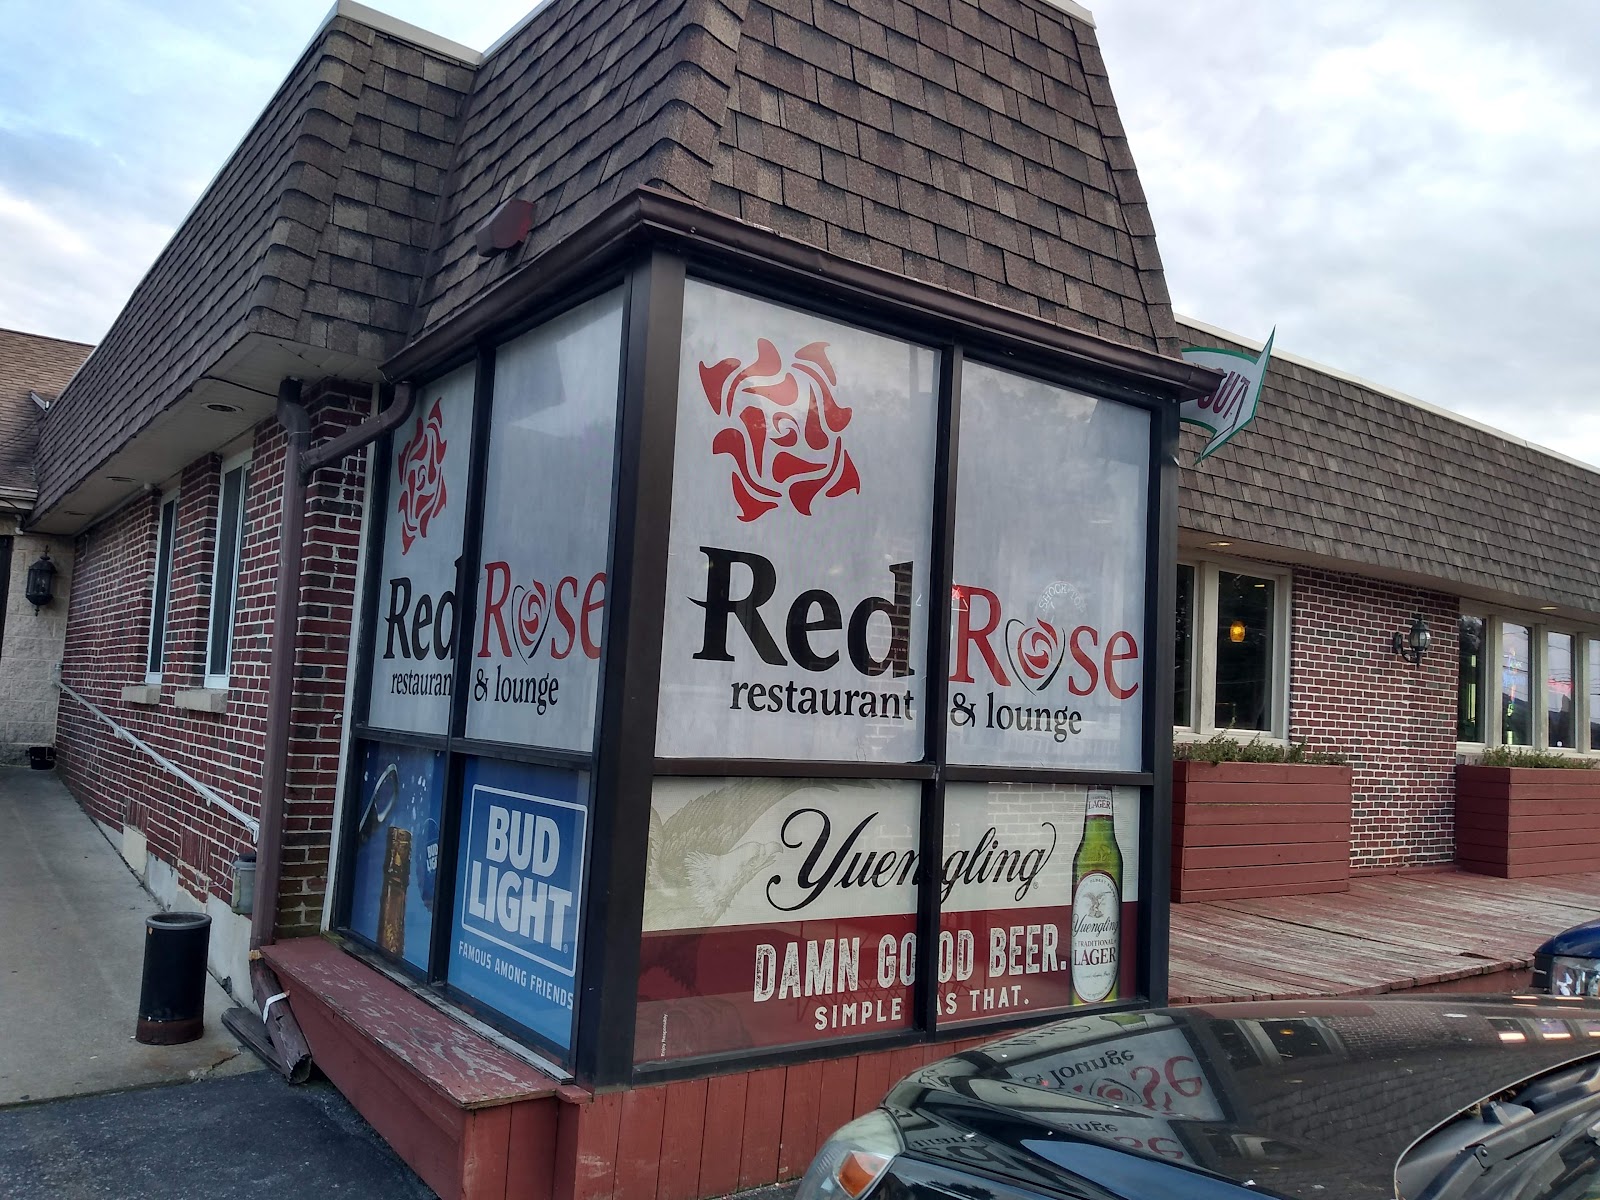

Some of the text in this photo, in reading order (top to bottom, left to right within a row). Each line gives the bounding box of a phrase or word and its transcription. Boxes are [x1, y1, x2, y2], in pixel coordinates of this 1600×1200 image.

[383, 555, 607, 662] Red Rose
[686, 546, 1139, 700] Red Rose
[390, 665, 559, 716] restauran & lounge
[729, 679, 1082, 744] restaurant & lounge
[1088, 799, 1111, 810] LAGER
[486, 805, 560, 877] BUD
[766, 808, 1057, 912] Yuengling
[469, 860, 573, 952] LIGHT
[1072, 913, 1119, 938] Yuengling
[458, 940, 574, 1011] FAMOUS AMONG FRIENDS
[753, 923, 1067, 1002] DAMN GOOD BEER.
[1074, 946, 1117, 966] LAGER
[814, 997, 902, 1031] SIMPLE
[970, 985, 1030, 1012] THAT.
